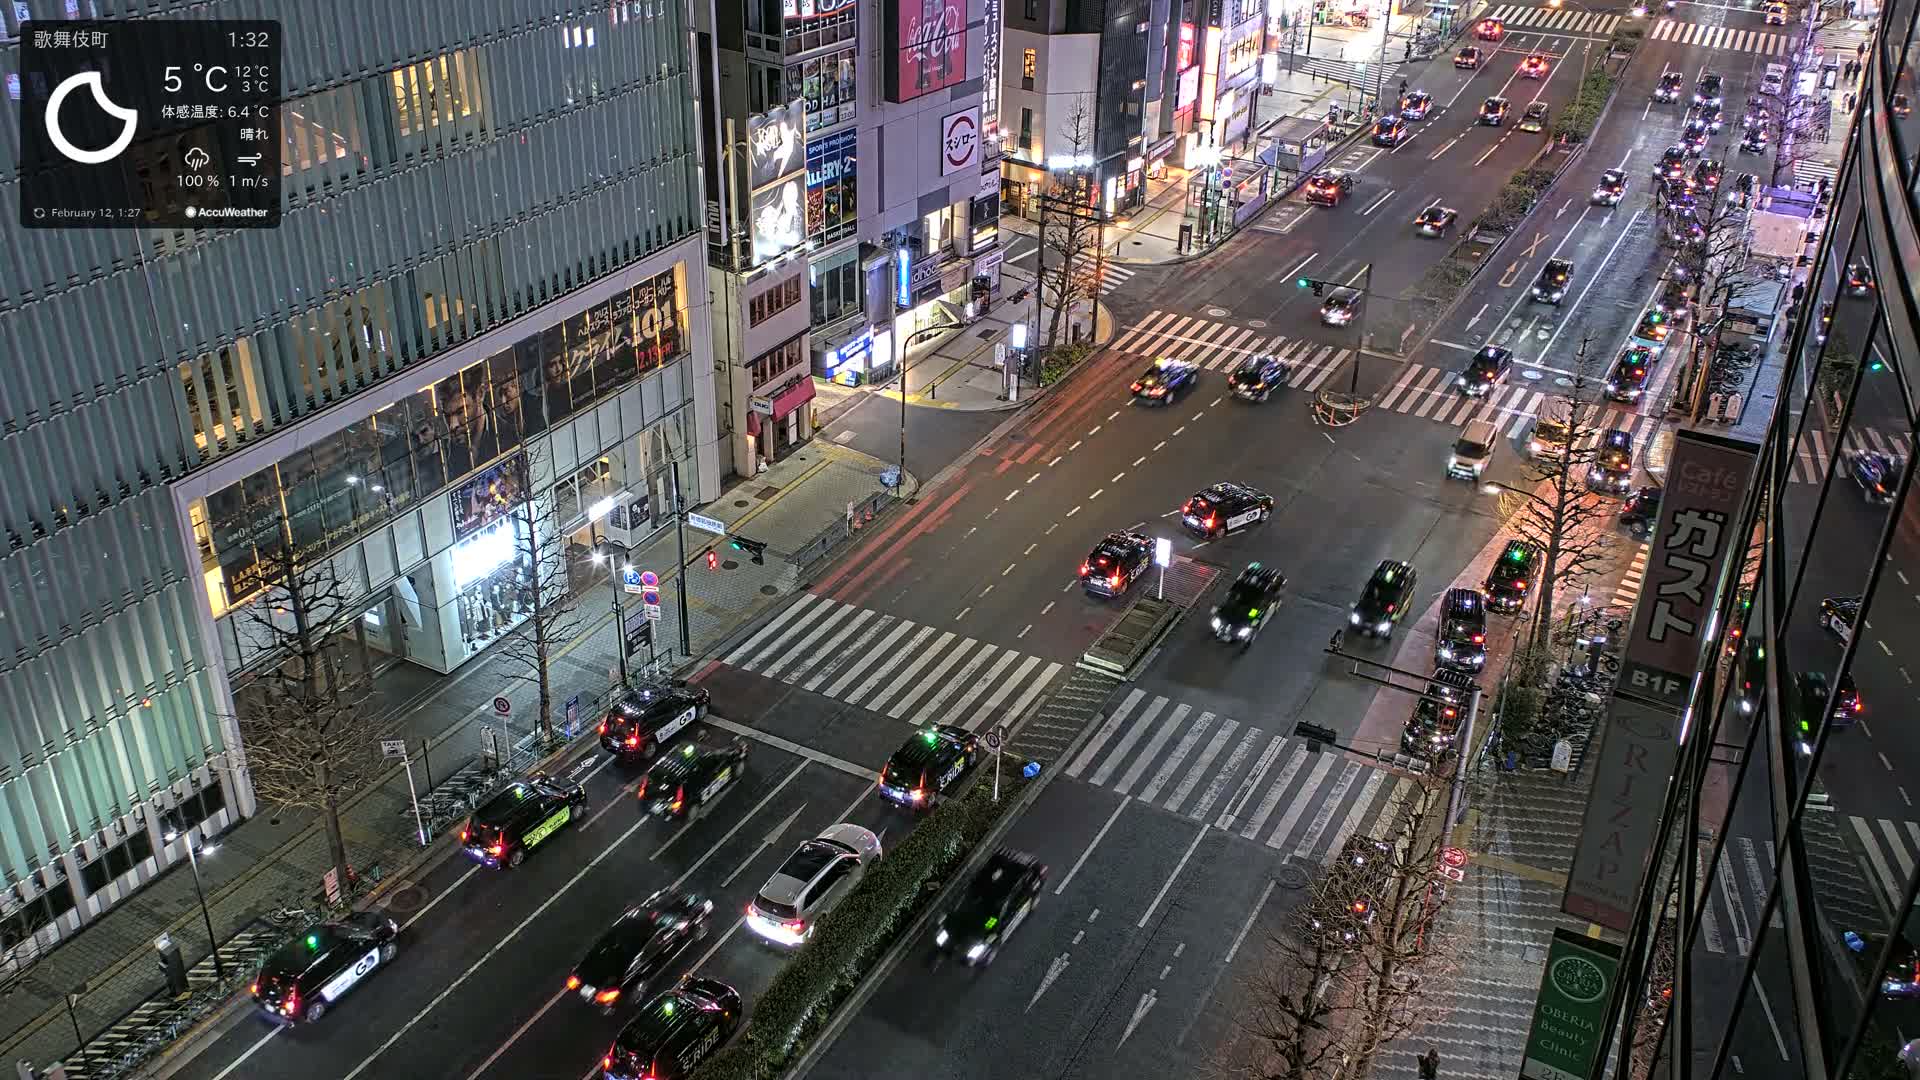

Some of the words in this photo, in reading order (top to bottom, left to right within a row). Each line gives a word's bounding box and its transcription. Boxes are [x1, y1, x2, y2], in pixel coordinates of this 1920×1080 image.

[945, 133, 976, 154] スシロー
[708, 200, 720, 233] MUJI
[1650, 508, 1727, 642] ガスト
[1631, 670, 1680, 695] B1F
[1596, 743, 1648, 881] RIZAP
[1541, 1004, 1594, 1032] OBERIA
[1541, 1020, 1585, 1046] Beauty
[1540, 1039, 1581, 1062] Clinic
